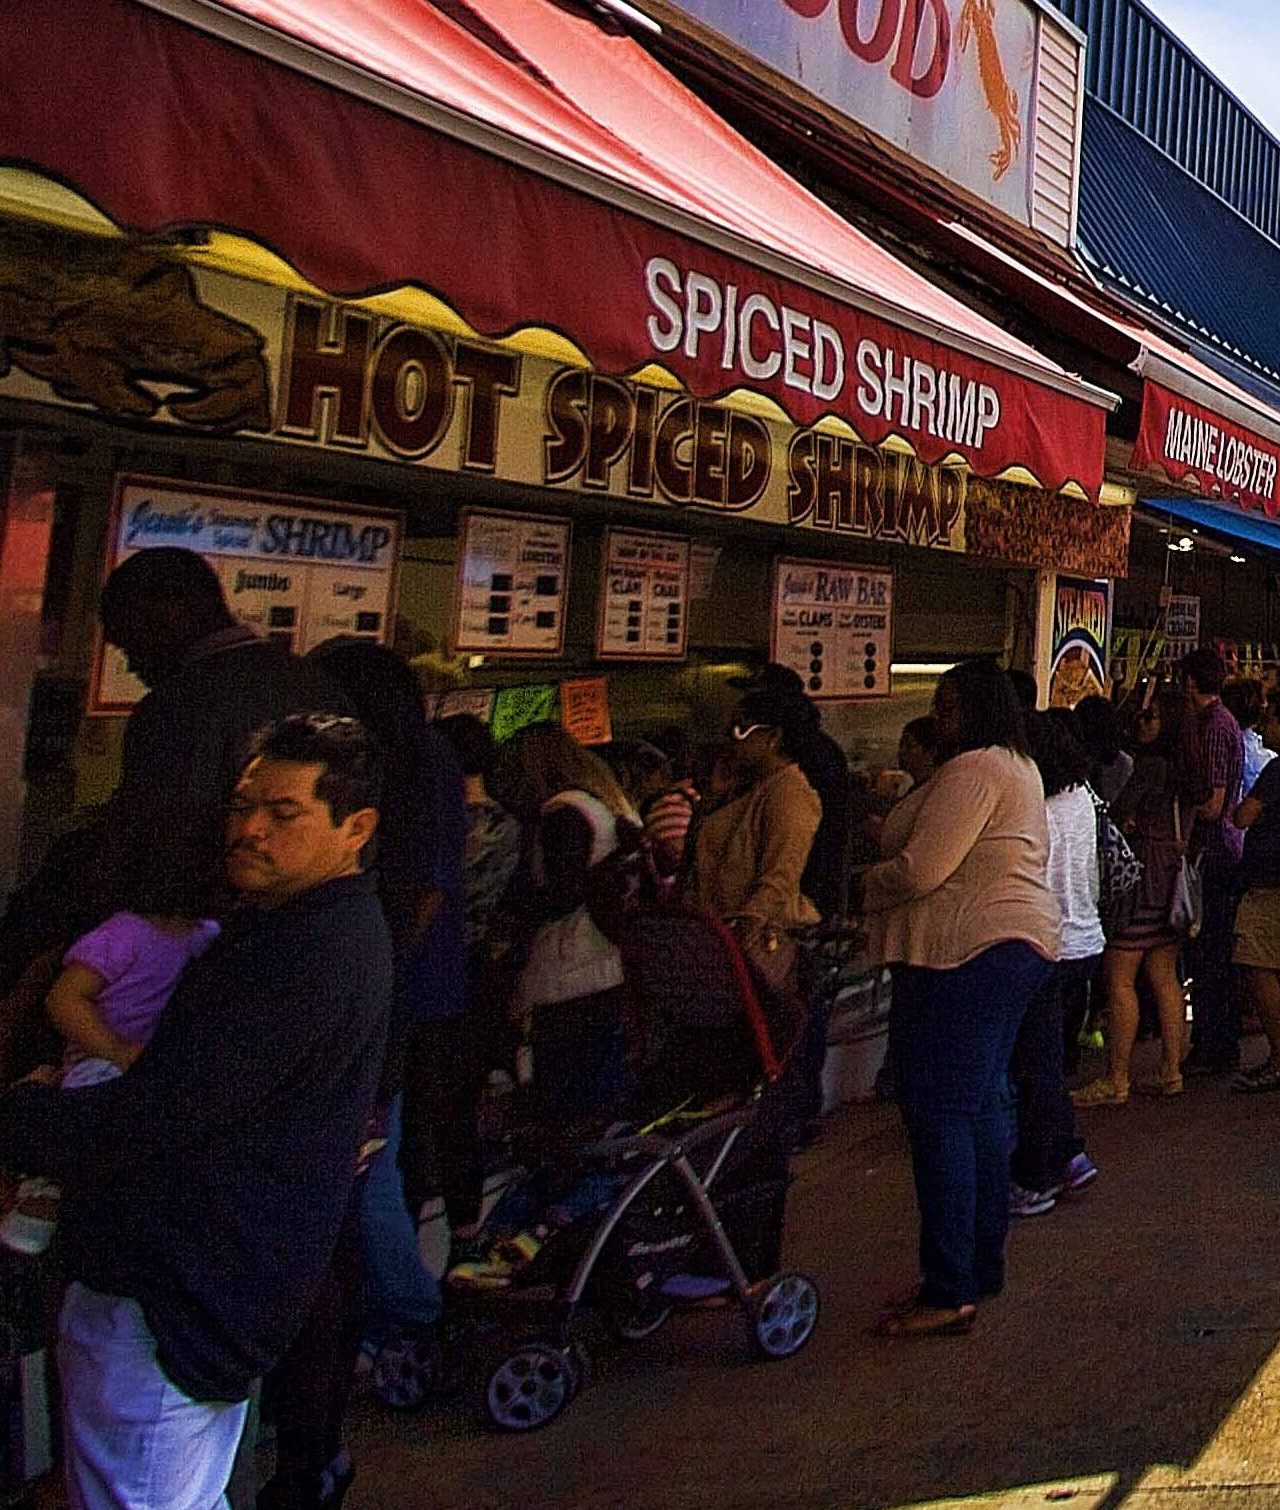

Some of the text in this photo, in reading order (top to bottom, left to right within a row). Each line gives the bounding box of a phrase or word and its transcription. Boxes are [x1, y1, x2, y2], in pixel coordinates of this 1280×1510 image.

[646, 257, 1000, 449] SPICED SHRIMP
[277, 294, 967, 548] HOT SPICED SHRIMP
[1164, 407, 1277, 498] MAINE LOBSTER
[262, 514, 391, 562] SHRIMP
[815, 572, 854, 601] RAW
[857, 576, 887, 605] BAR
